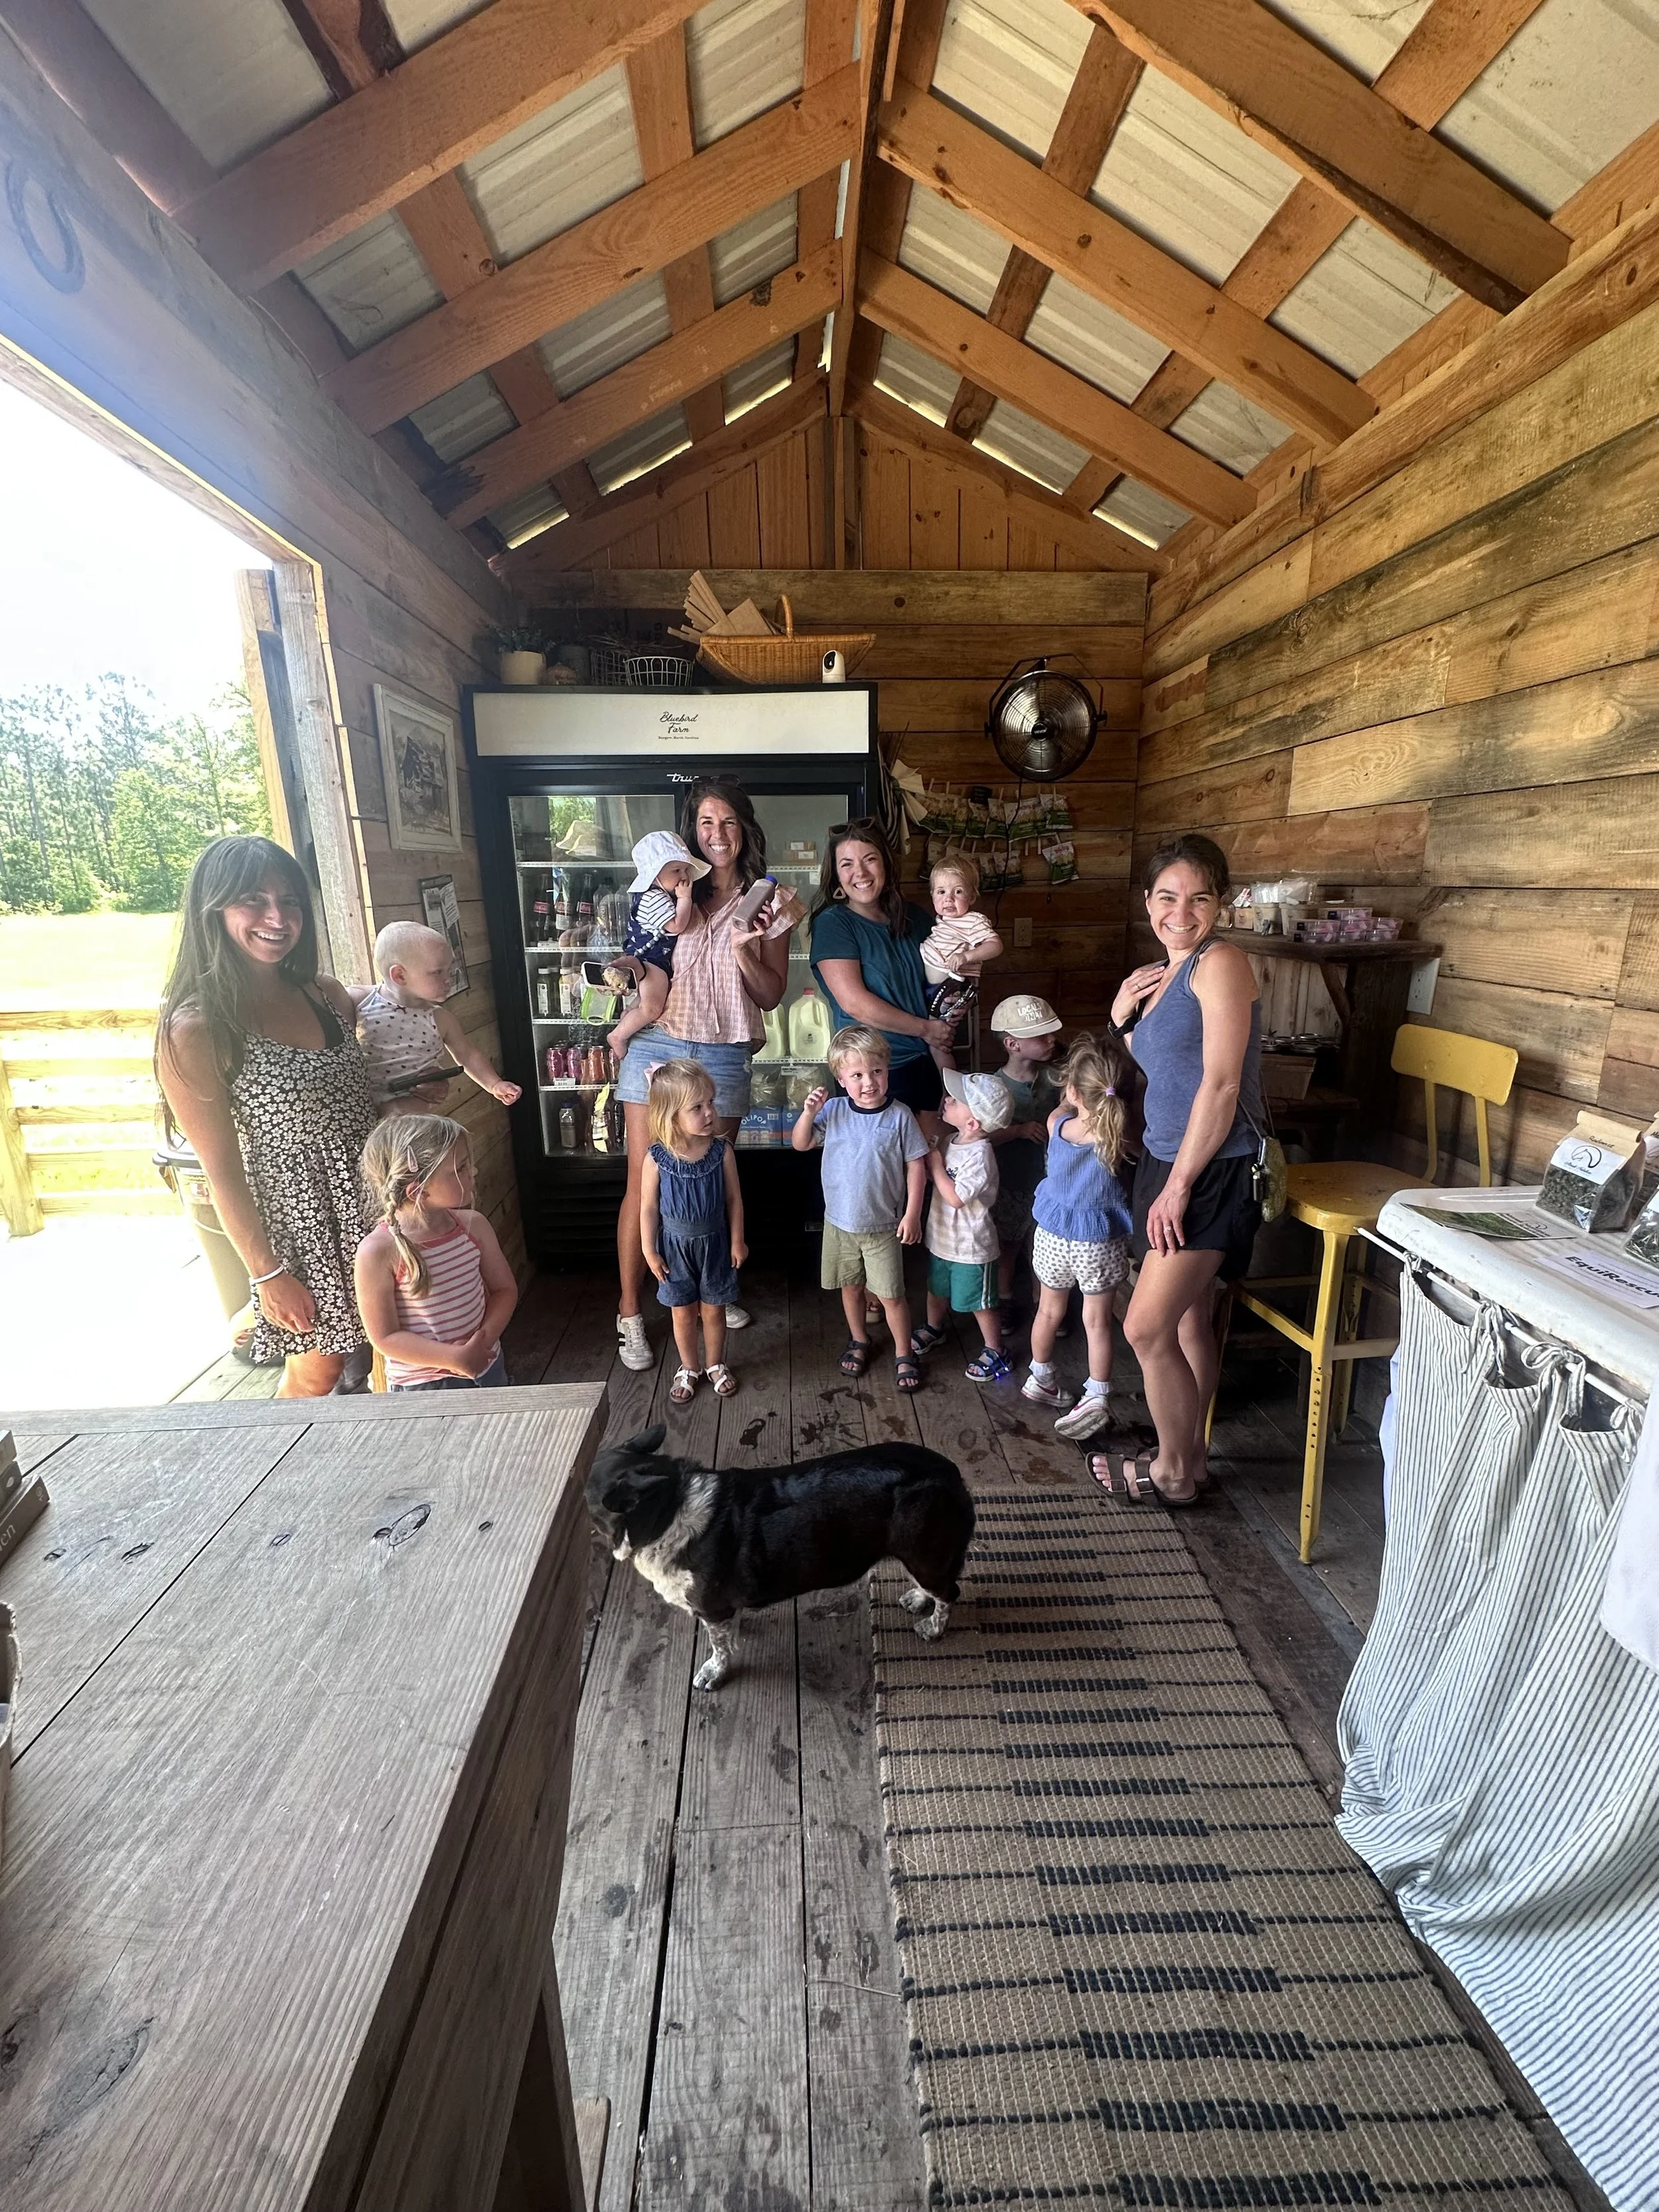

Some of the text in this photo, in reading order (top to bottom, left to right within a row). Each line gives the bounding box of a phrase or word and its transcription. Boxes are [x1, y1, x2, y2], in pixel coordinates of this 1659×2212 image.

[660, 711, 699, 722] Bluebird
[668, 722, 689, 733] Farm
[1017, 1003, 1042, 1017] LOCALS
[741, 1114, 766, 1125] OLIPOP
[1589, 1136, 1615, 1148] Radiance
